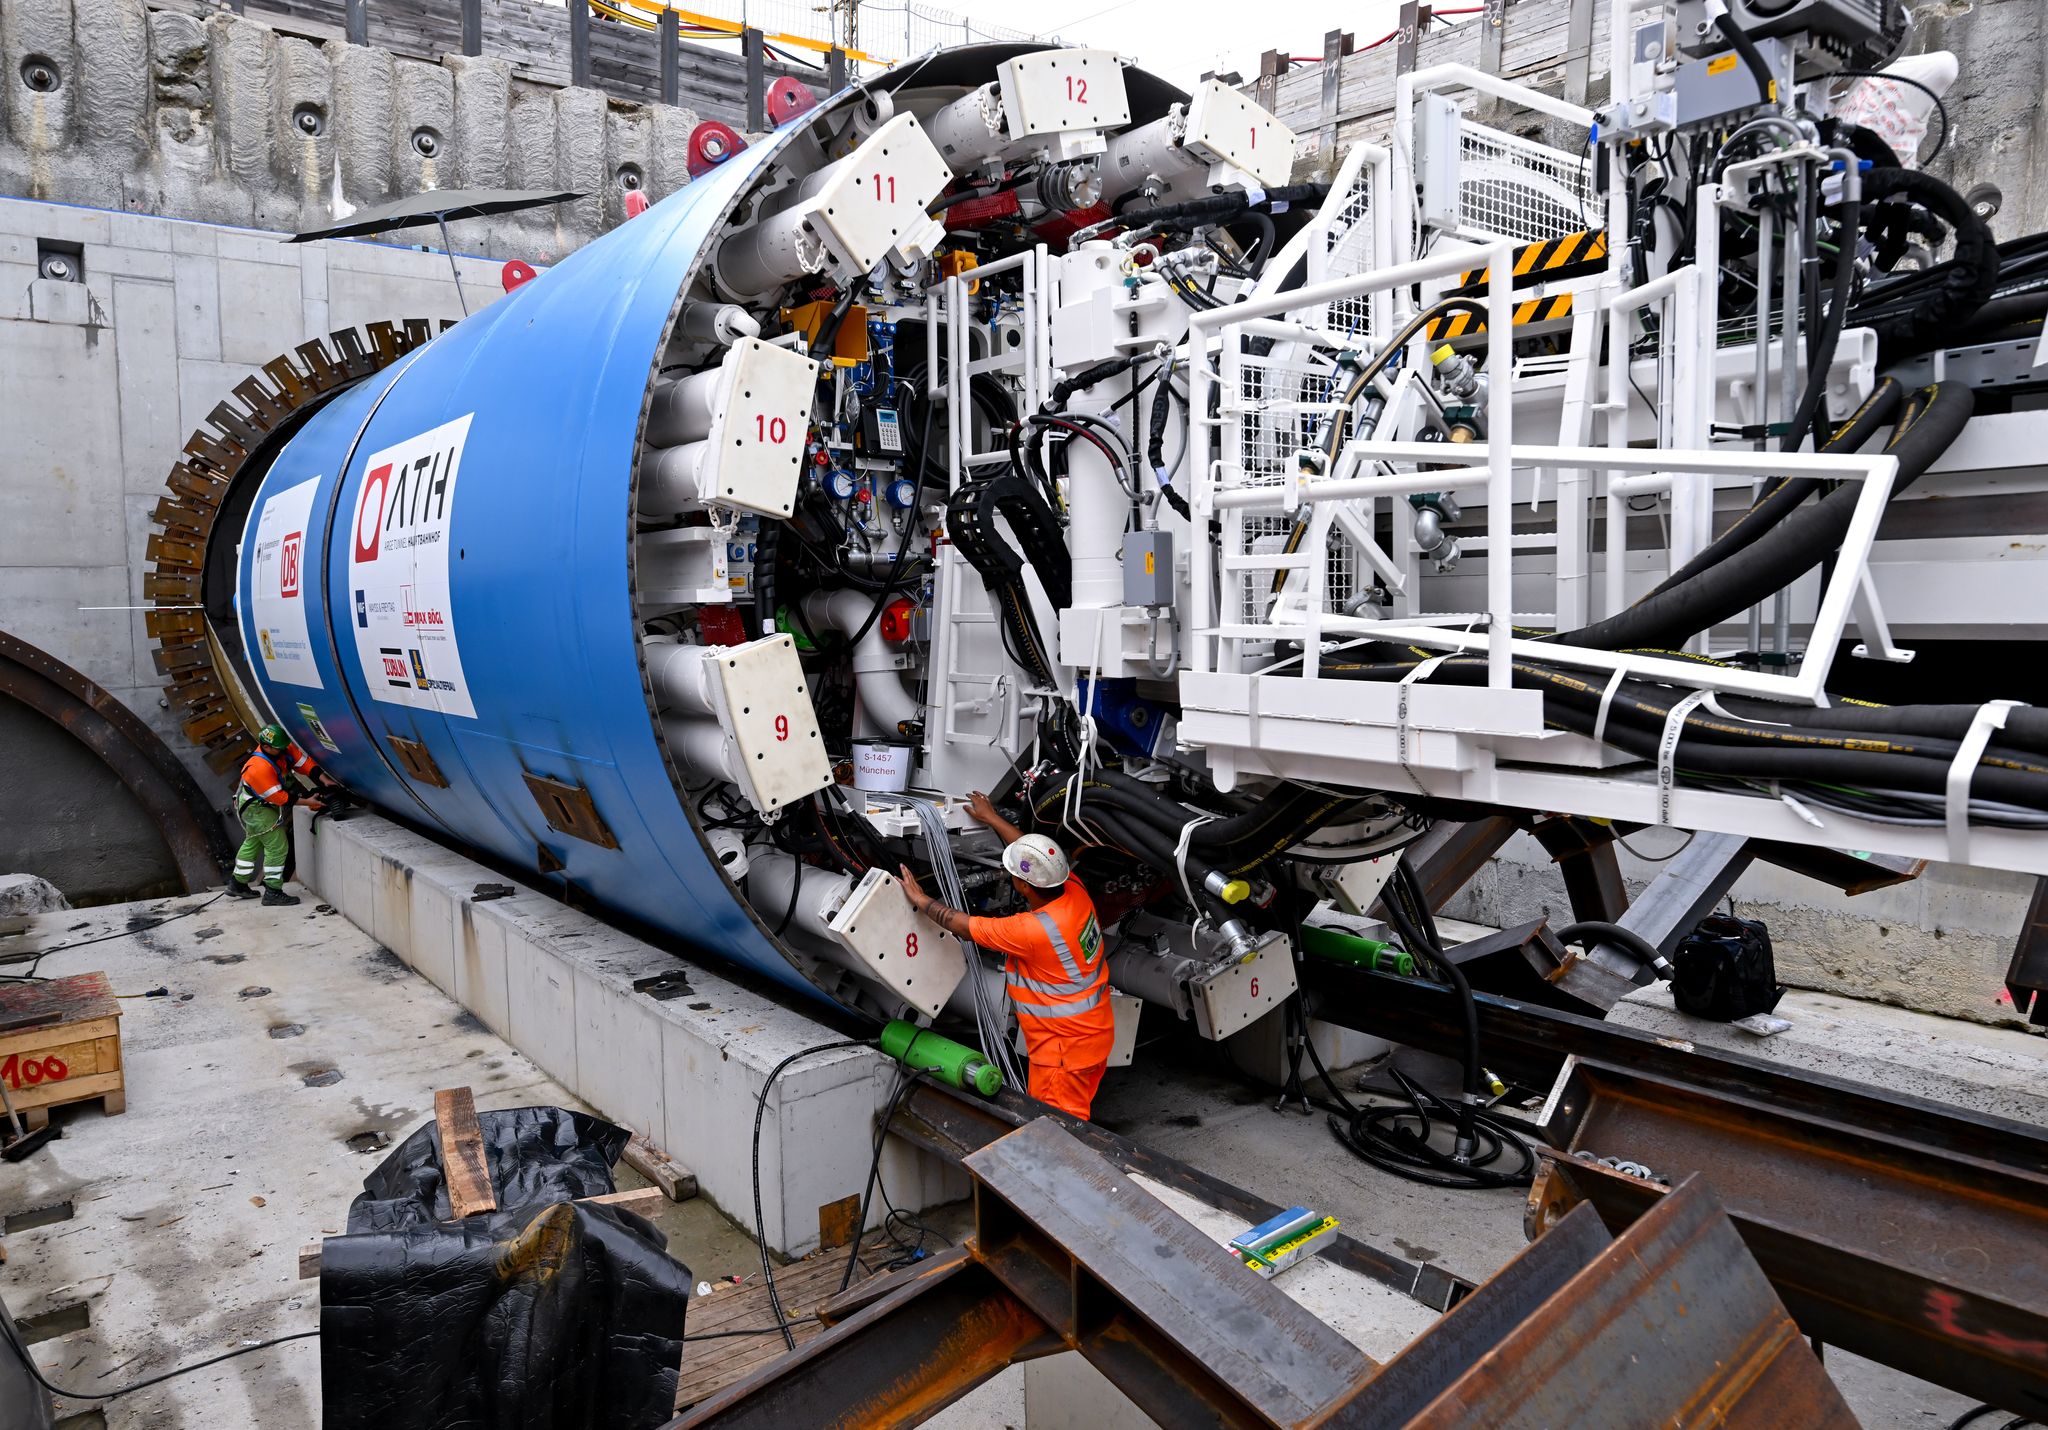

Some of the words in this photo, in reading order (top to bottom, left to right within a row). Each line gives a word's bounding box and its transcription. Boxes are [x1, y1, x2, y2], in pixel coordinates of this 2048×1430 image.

[1399, 24, 1413, 45] 39
[1066, 76, 1087, 104] 12
[1260, 75, 1273, 90] 43
[1250, 127, 1256, 150] 1
[873, 173, 895, 204] 11
[756, 414, 786, 444] 10
[283, 542, 298, 588] DB
[414, 611, 428, 624] MAX
[775, 714, 788, 742] 9
[864, 752, 892, 763] S-1457
[859, 765, 896, 776] München
[906, 932, 919, 958] 8
[1251, 977, 1259, 998] 6
[0, 1053, 68, 1088] 100
